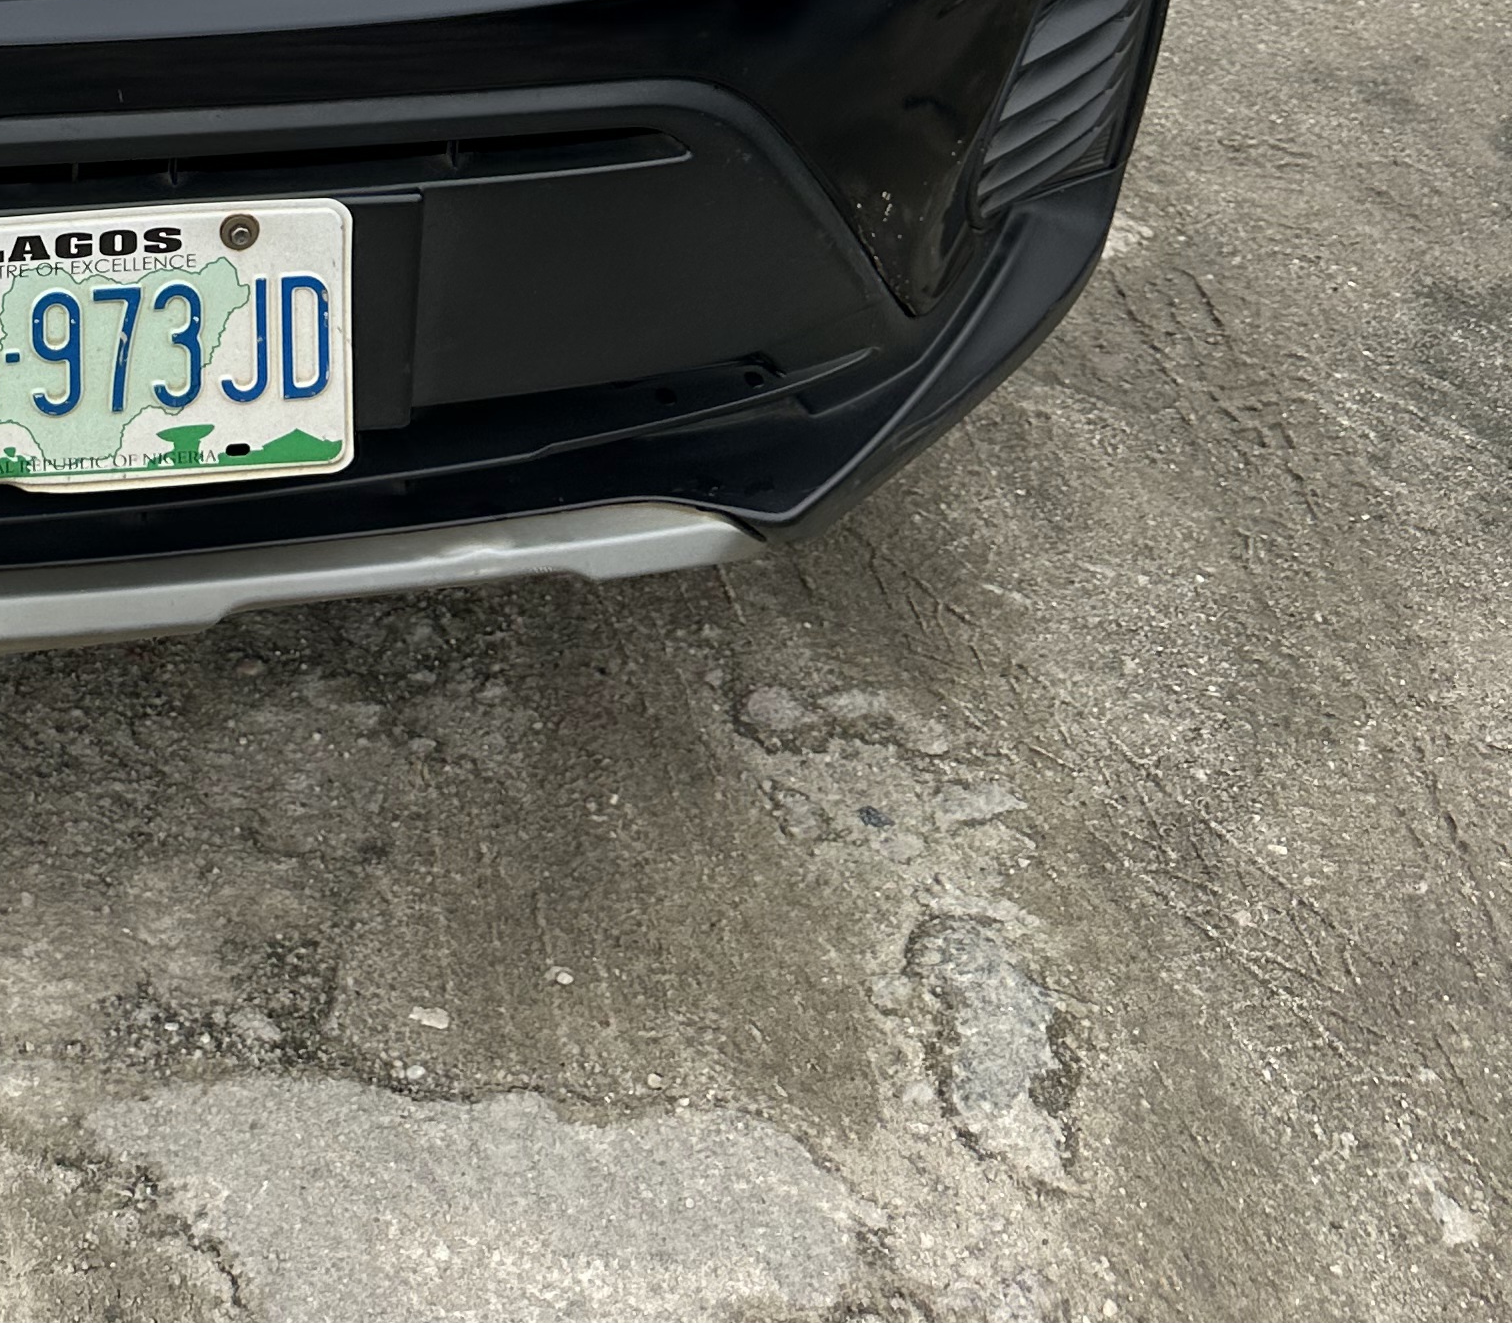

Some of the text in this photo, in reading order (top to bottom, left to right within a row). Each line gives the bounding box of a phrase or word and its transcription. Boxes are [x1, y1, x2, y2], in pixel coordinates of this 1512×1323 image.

[36, 261, 65, 277] OF
[71, 253, 197, 275] EXCELLENCE
[19, 455, 109, 474] REPUBLIC
[112, 453, 139, 468] OF
[143, 449, 218, 466] NIGERIA
